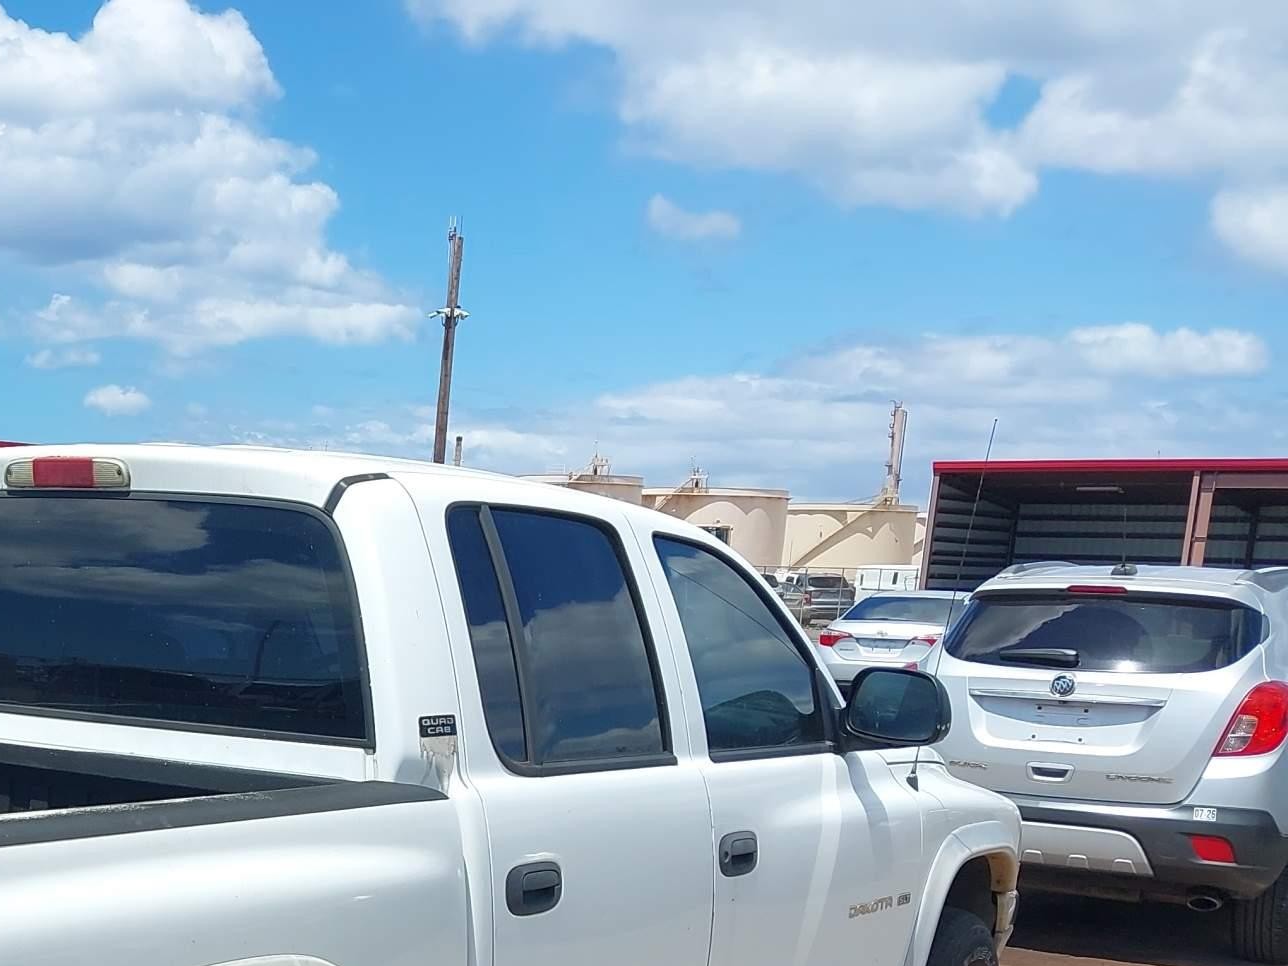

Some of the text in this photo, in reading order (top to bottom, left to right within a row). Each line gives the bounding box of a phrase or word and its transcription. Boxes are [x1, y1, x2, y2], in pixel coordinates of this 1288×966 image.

[422, 717, 454, 726] QUAD
[427, 726, 451, 734] CAB
[848, 896, 893, 918] DAKOTA
